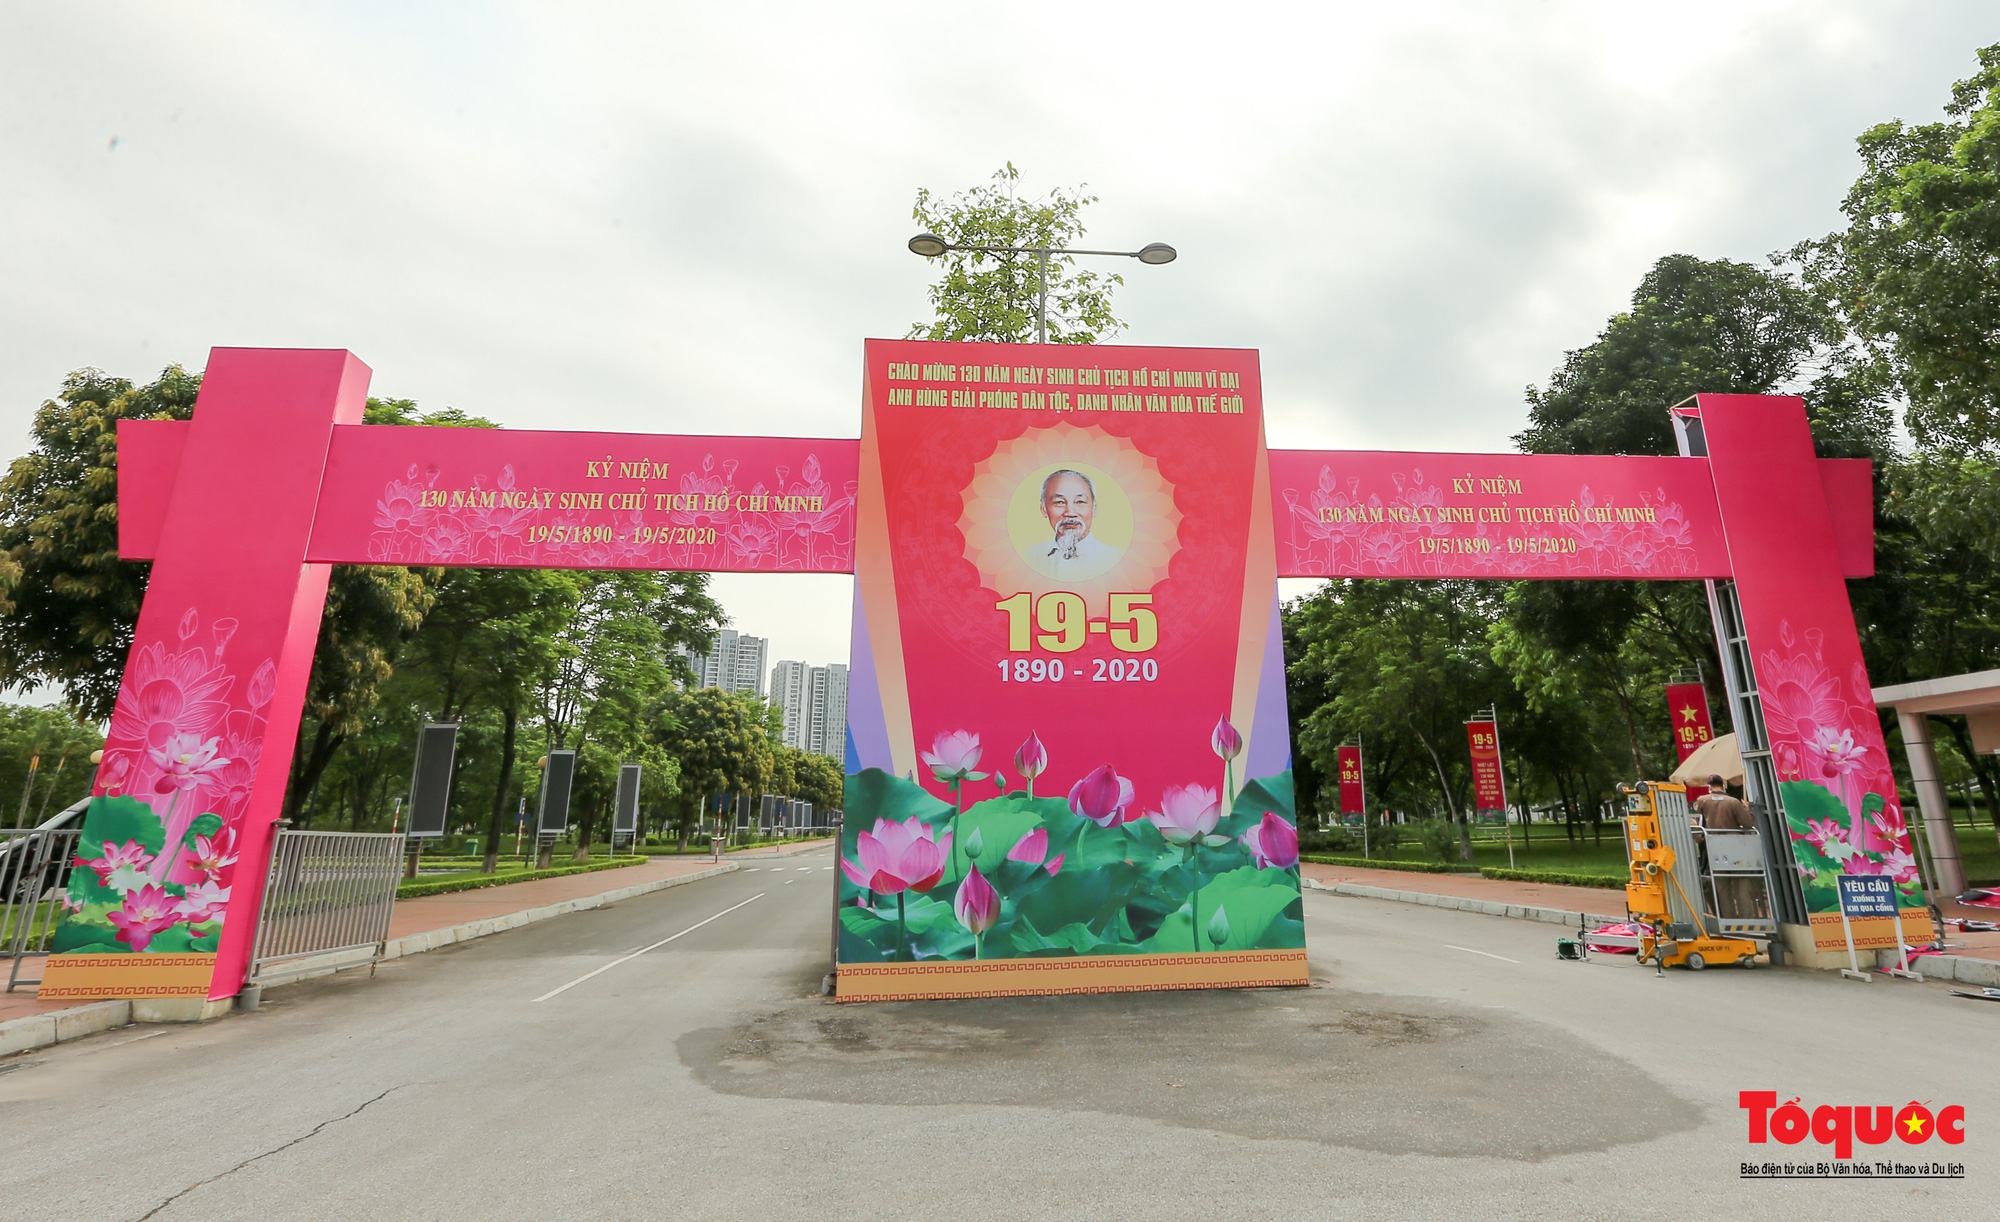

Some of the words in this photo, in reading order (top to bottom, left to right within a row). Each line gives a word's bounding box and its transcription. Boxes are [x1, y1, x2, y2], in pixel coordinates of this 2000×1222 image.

[888, 361, 919, 380] CHÀO
[922, 362, 957, 381] MỪNG
[959, 365, 981, 383] 130
[984, 364, 1010, 383] NĂM
[1014, 365, 1044, 384] NGÀY
[1047, 368, 1074, 385] SINH
[1077, 365, 1101, 386] CHỦ
[1104, 369, 1129, 390] TỊCH
[1132, 367, 1148, 387] HỒ
[1151, 368, 1170, 387] CHÍ
[1173, 371, 1203, 388] MINH
[1205, 369, 1217, 388] VĨ
[1220, 372, 1240, 392] ĐẠI
[888, 388, 912, 406] ANH
[916, 387, 948, 407] HÙNG
[951, 386, 976, 408] GIẢI
[979, 389, 1018, 409] PHÓNG
[1021, 390, 1045, 410] DÂN
[1048, 390, 1074, 413] TỘC,
[1077, 394, 1108, 411] DANH
[1111, 392, 1142, 412] NHÂN
[1145, 394, 1167, 412] VĂN
[1170, 394, 1193, 413] HÓA
[1196, 393, 1217, 413] THẾ
[1220, 395, 1244, 414] GIỚI
[585, 455, 614, 478] KỶ
[618, 457, 669, 483] NIỆM
[1452, 472, 1475, 494] KỶ
[1480, 474, 1522, 497] NIỆM
[419, 490, 447, 508] 130
[450, 487, 497, 508] NĂM
[499, 487, 556, 509] NGÀY
[558, 492, 603, 510] SINH
[608, 487, 648, 511] CHỦ
[654, 494, 699, 514] TỊCH
[703, 486, 730, 512] HỒ
[735, 491, 770, 512] CHÍ
[773, 495, 823, 513] MINH
[1318, 507, 1342, 523] 130
[1346, 504, 1384, 523] NĂM
[1387, 503, 1433, 523] NGÀY
[1438, 507, 1475, 523] SINH
[1478, 502, 1511, 523] CHỦ
[1516, 507, 1555, 526] TỊCH
[1557, 499, 1580, 523] HỒ
[1584, 503, 1613, 523] CHÍ
[1614, 507, 1657, 523] MINH
[527, 525, 613, 543] 19/5/1890
[632, 527, 716, 545] 19/5/2020
[1418, 538, 1490, 554] 19/5/1890
[1506, 537, 1577, 554] 19/5/2020
[995, 591, 1158, 653] 19-5
[997, 659, 1065, 682] 1890
[1092, 659, 1158, 682] 2020
[1472, 733, 1493, 745] 19-5
[1678, 726, 1708, 742] 19-5
[1342, 770, 1359, 780] 19-5
[1844, 880, 1865, 892] YÊU
[1867, 879, 1890, 892] CẦU
[1875, 903, 1895, 912] CỐNG
[1876, 895, 1886, 903] XE
